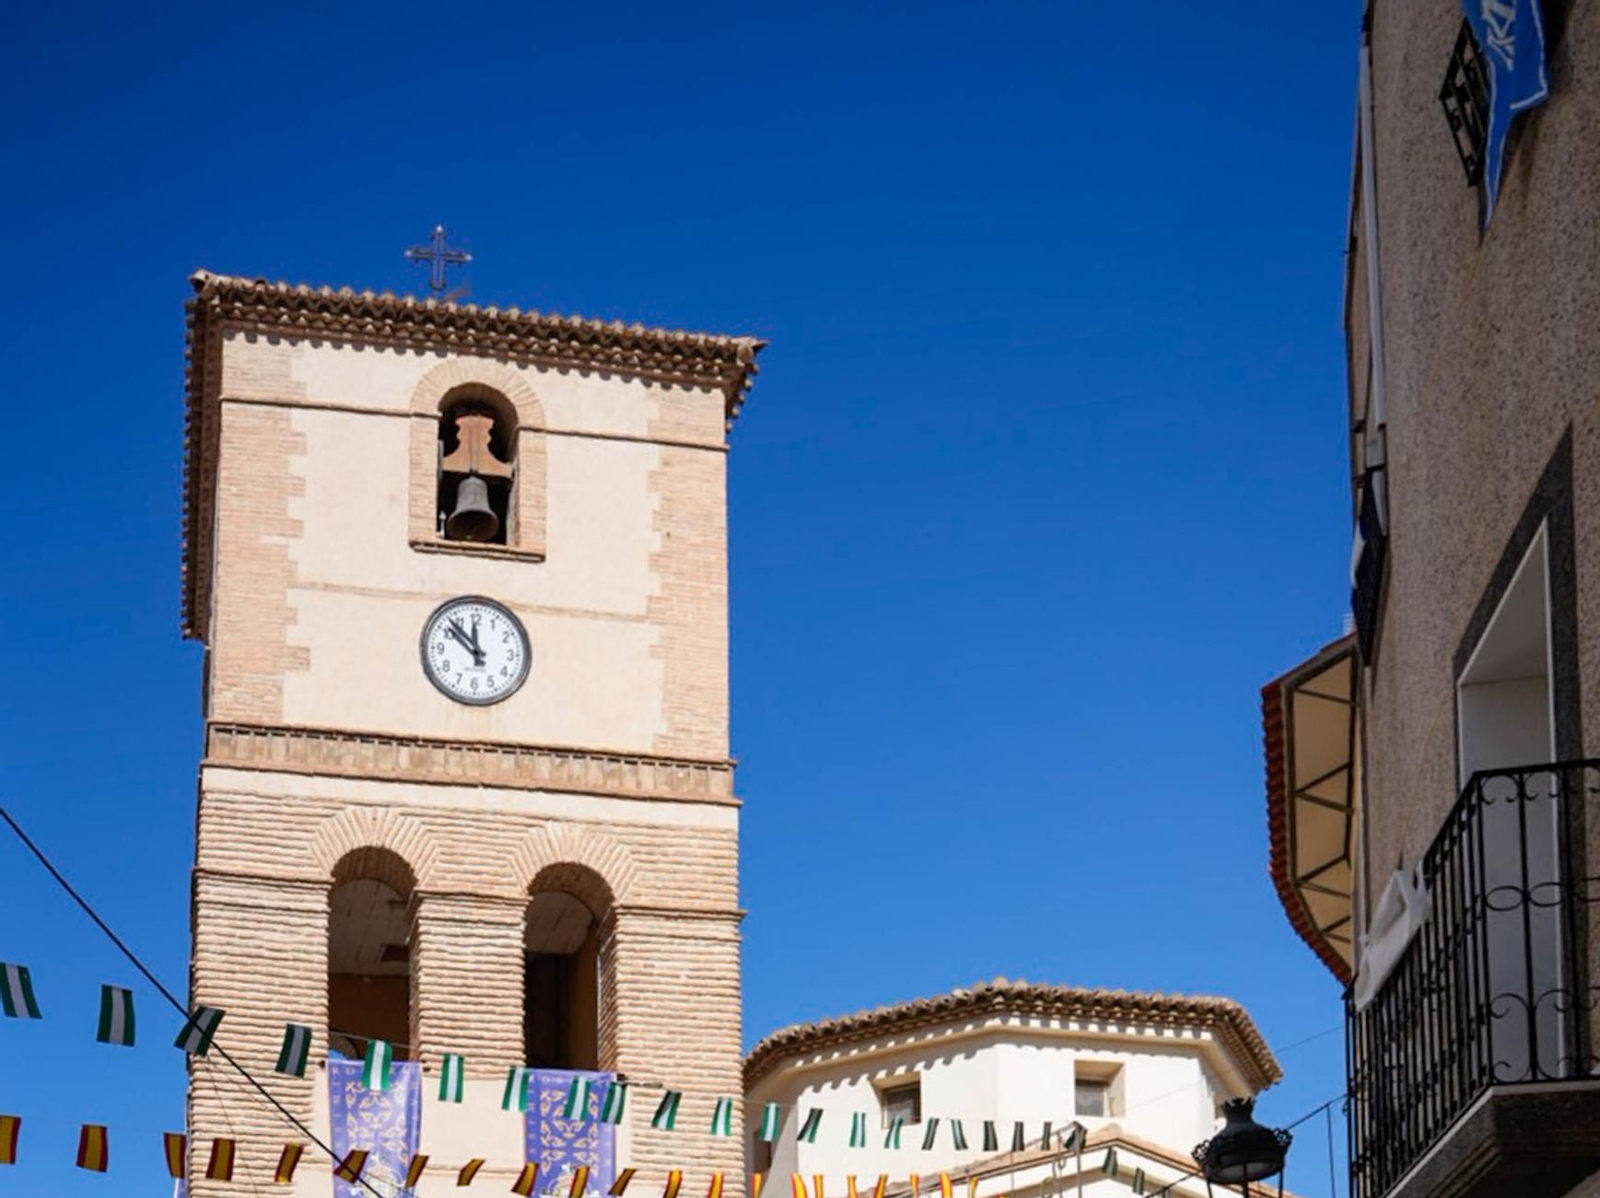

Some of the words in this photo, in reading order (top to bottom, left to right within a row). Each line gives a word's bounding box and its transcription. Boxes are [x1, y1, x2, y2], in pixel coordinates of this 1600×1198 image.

[502, 631, 510, 643] 2
[437, 642, 445, 655] 9
[506, 649, 515, 661] 3
[442, 660, 450, 672] 8
[500, 666, 508, 678] 4
[456, 673, 463, 684] 7
[470, 677, 479, 690] 6
[487, 675, 495, 687] 5
